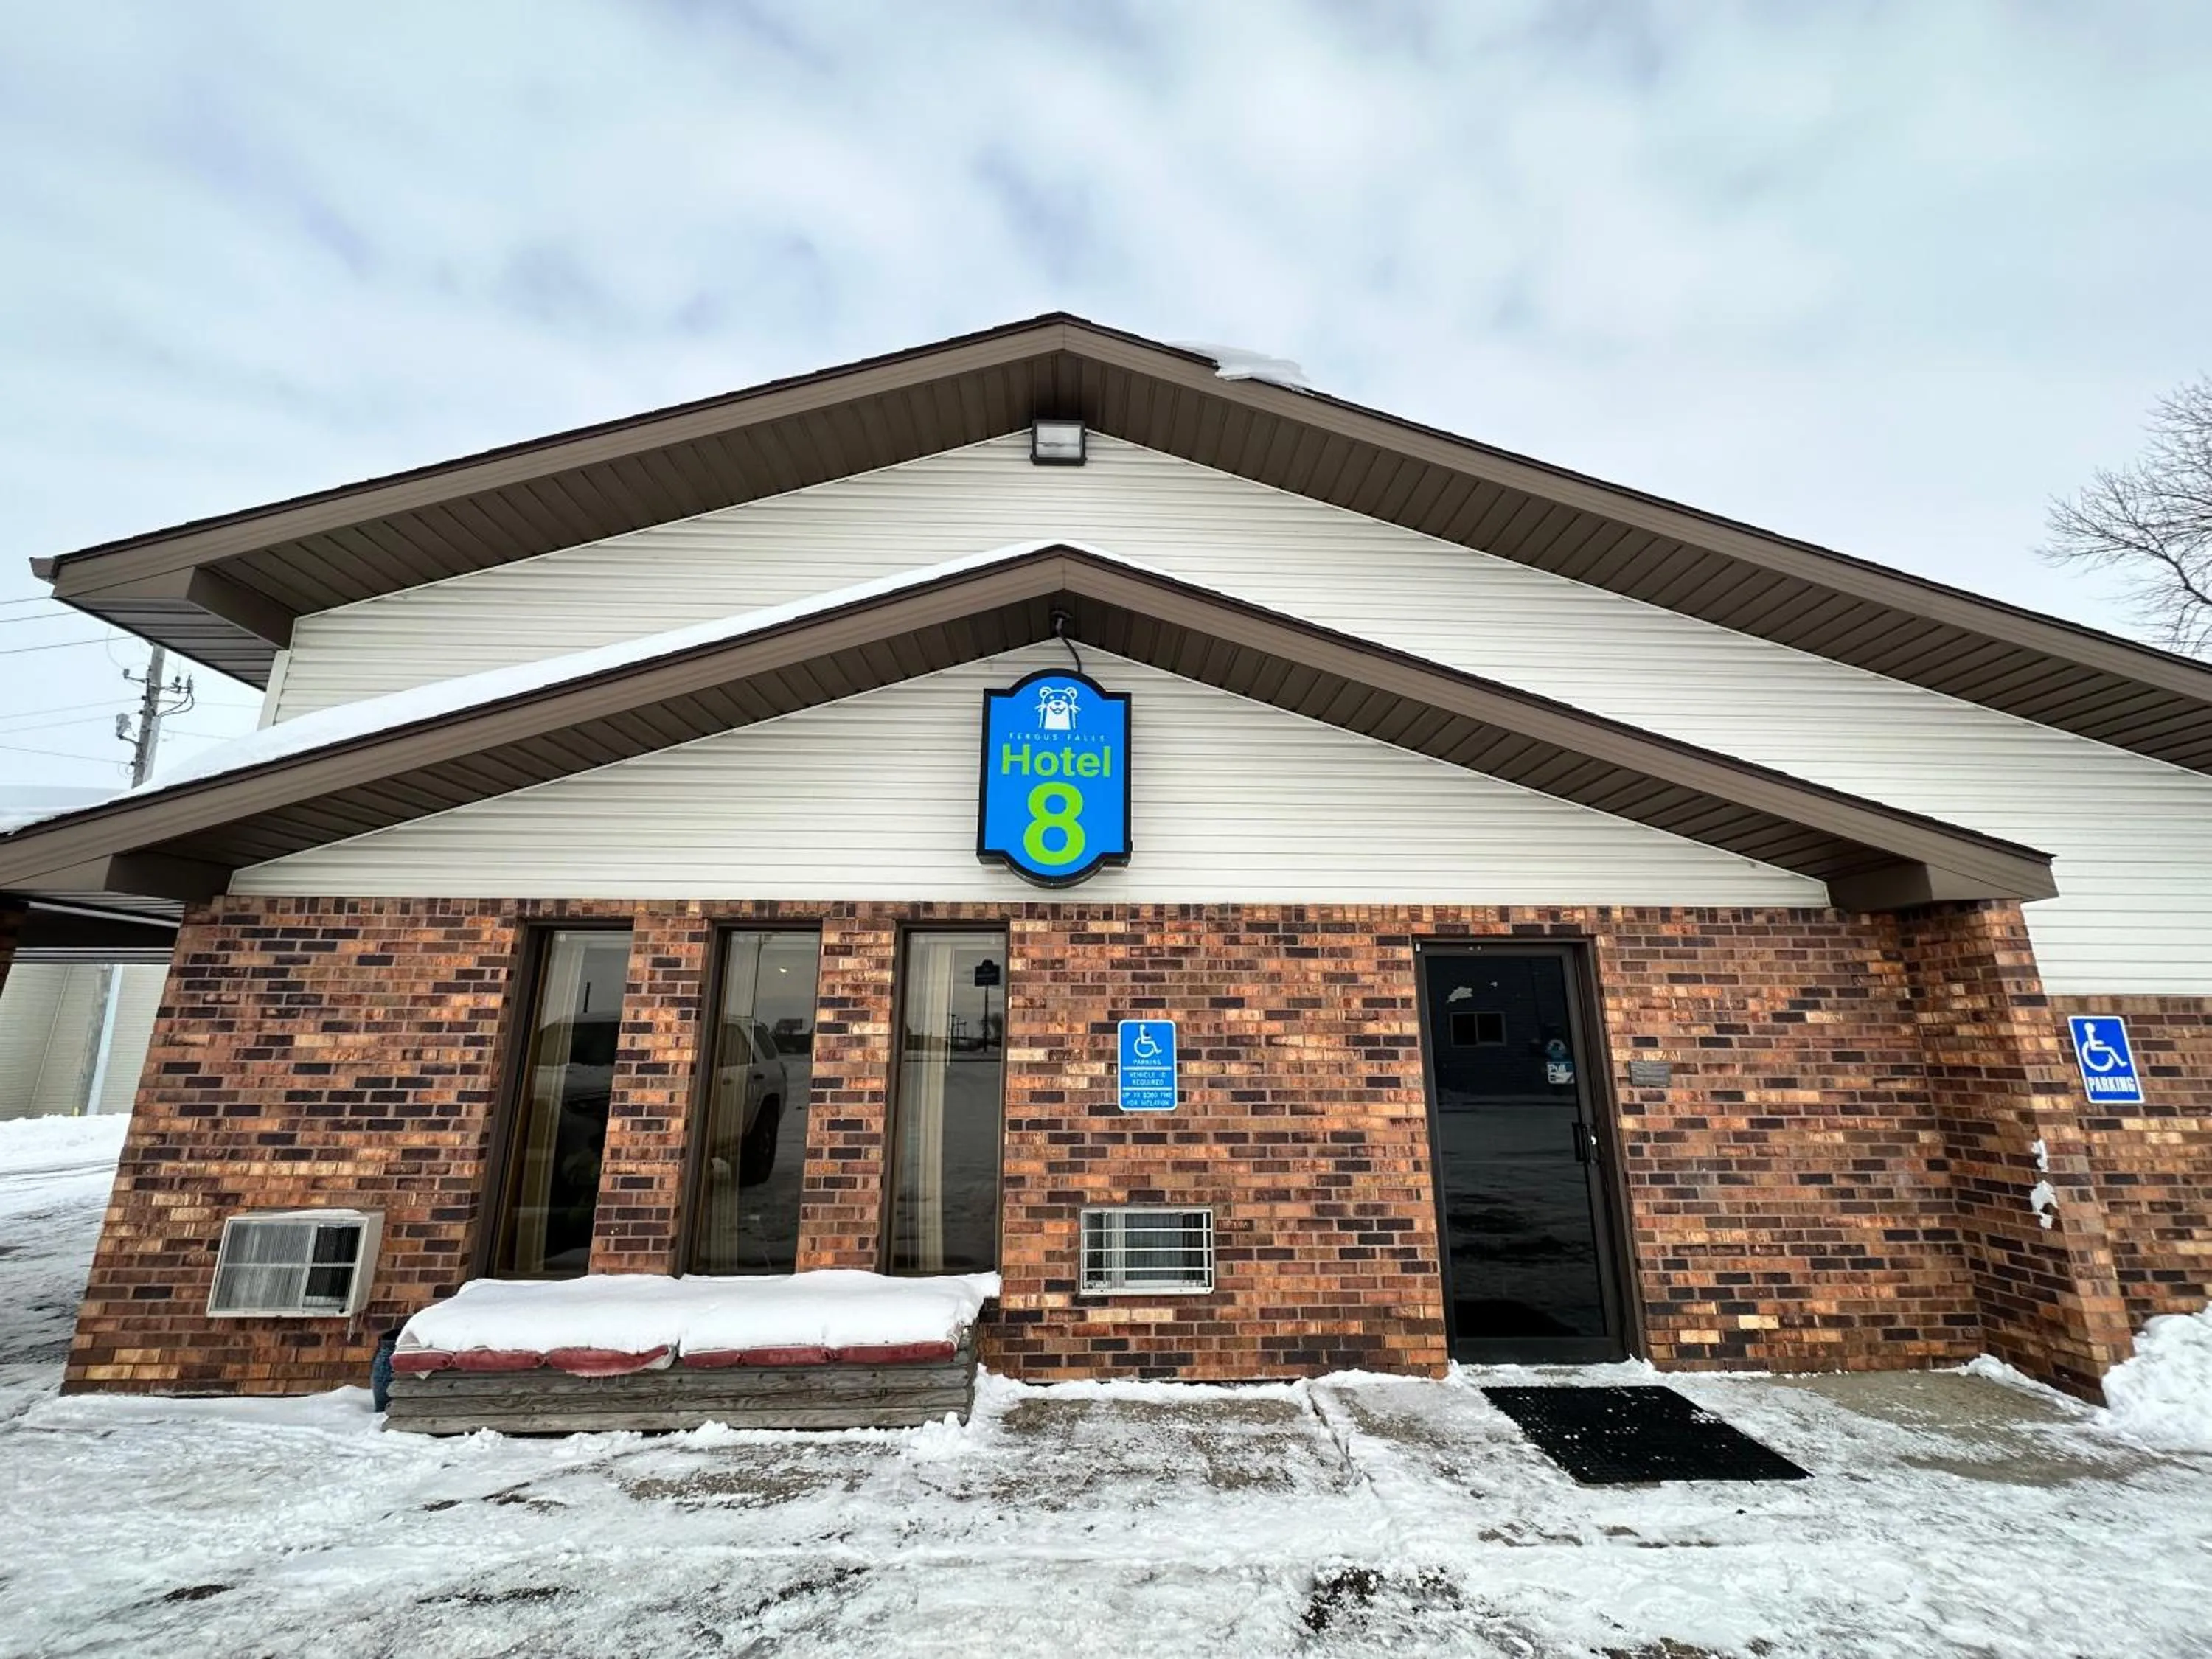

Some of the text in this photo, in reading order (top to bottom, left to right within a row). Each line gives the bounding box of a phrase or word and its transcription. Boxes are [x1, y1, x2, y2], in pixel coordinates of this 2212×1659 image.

[1009, 731, 1105, 742] FERGUS FALLS
[1001, 743, 1111, 778] Hotel
[1023, 781, 1086, 866] 8
[2087, 1077, 2136, 1092] PARKING
